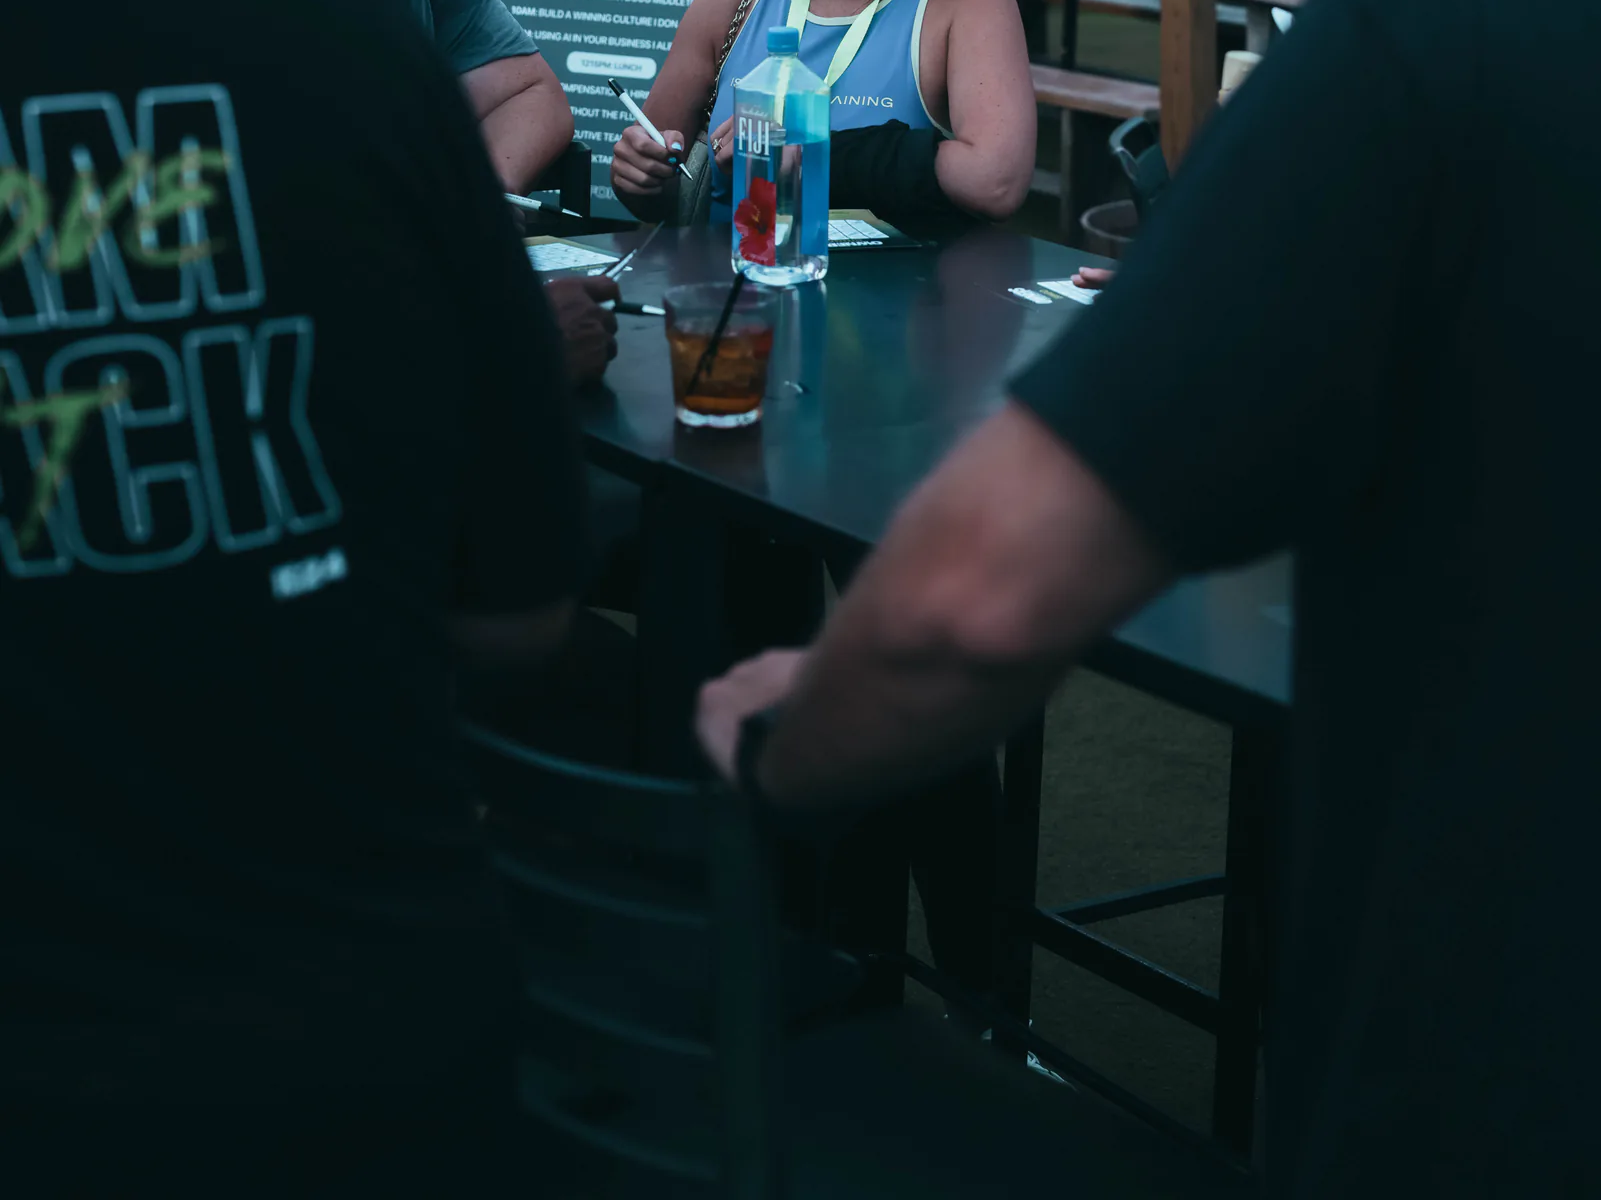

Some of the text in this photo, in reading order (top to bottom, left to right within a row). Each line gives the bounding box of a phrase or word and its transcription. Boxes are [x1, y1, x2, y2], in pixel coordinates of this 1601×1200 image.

[538, 8, 565, 19] BUILD
[565, 10, 572, 20] A
[572, 11, 612, 24] WINNING
[612, 14, 652, 27] CULTURE
[657, 17, 679, 29] DON
[534, 30, 562, 42] USING
[562, 33, 571, 42] AI
[572, 33, 582, 43] IN
[583, 35, 607, 46] YOUR
[608, 37, 652, 50] BUSINESS
[614, 62, 643, 73] LUNCH
[831, 95, 894, 108] AINING
[570, 106, 600, 118] THOUT
[601, 109, 619, 120] THE
[738, 116, 770, 156] FIJI
